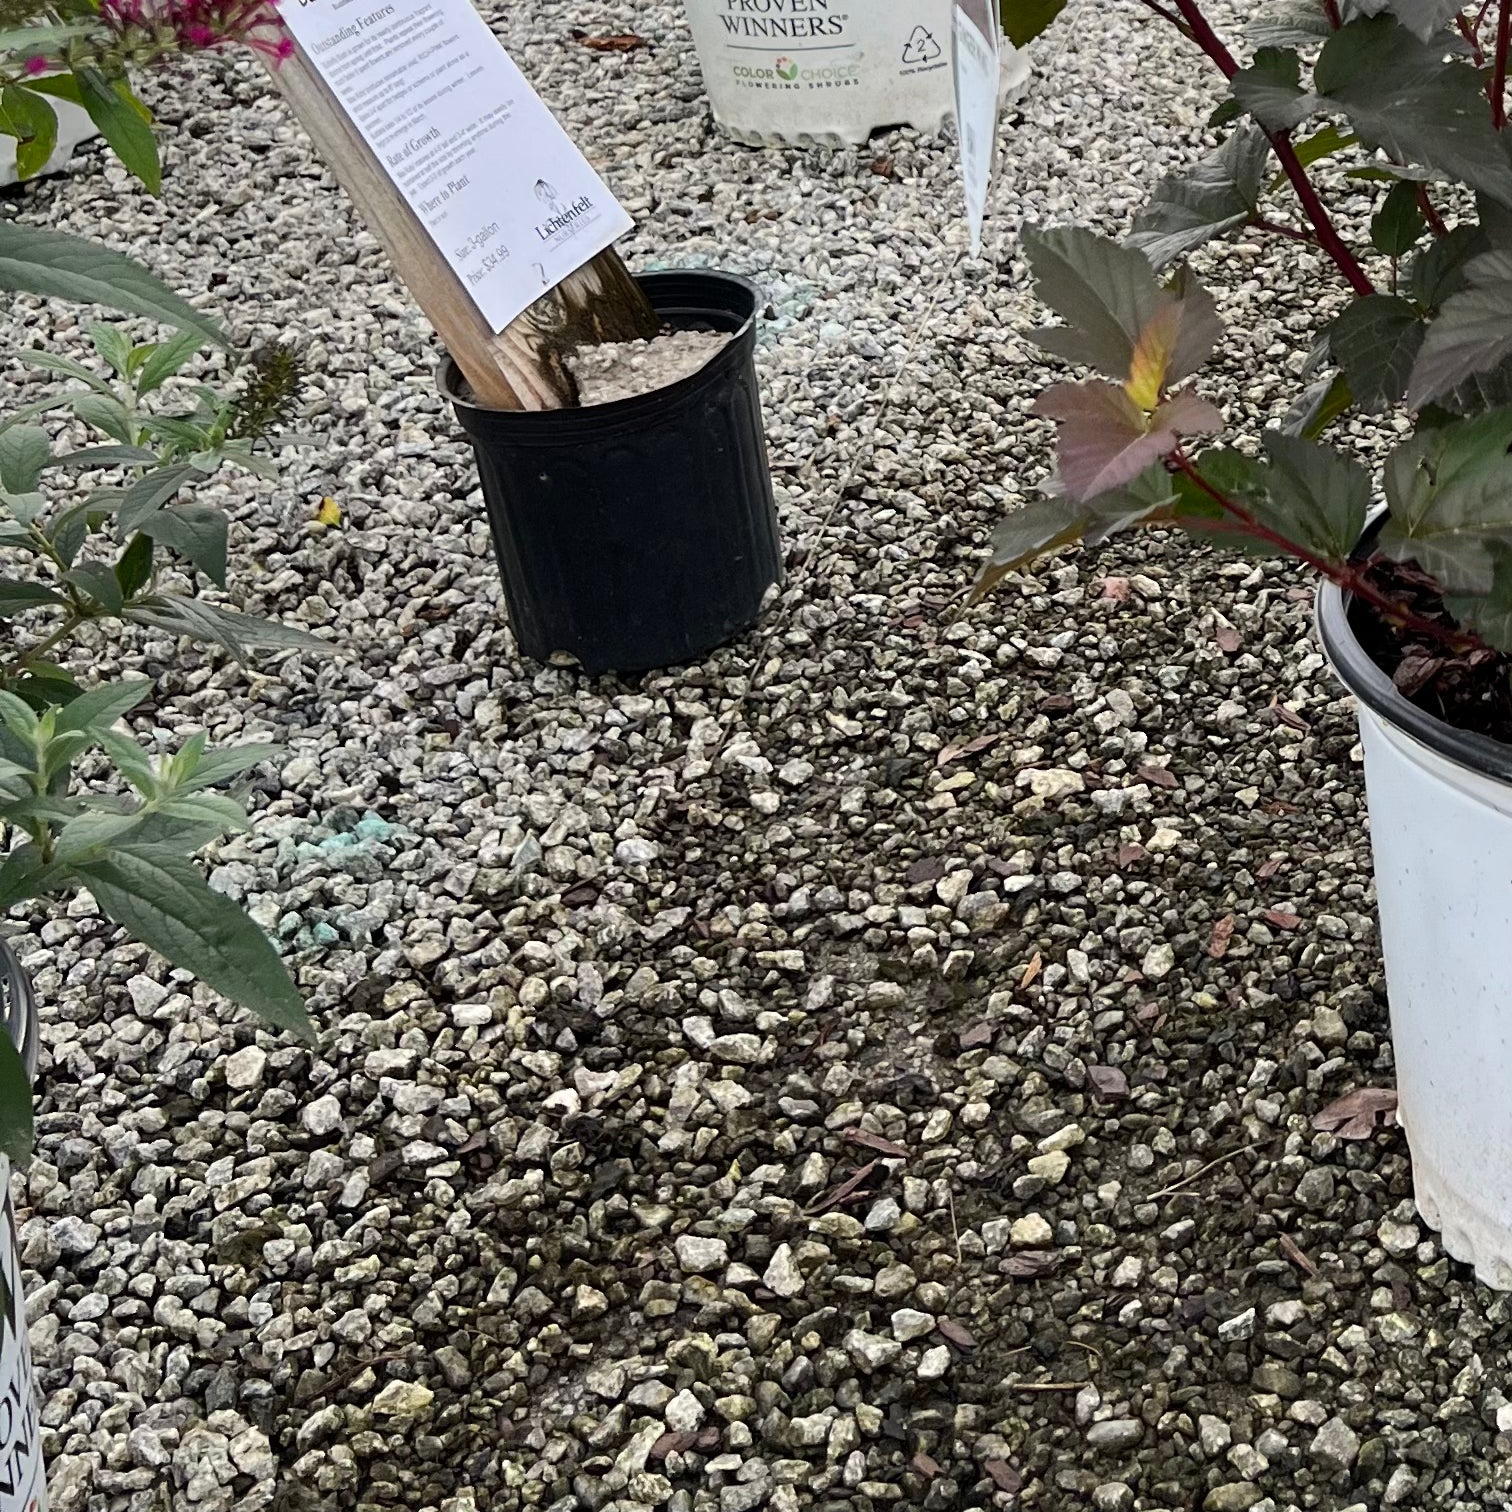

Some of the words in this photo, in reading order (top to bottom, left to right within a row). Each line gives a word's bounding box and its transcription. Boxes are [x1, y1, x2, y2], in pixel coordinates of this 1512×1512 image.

[355, 4, 396, 31] Features
[733, 65, 775, 80] COLOR
[385, 148, 403, 168] Rate
[410, 126, 441, 154] Growth
[441, 188, 450, 202] to
[447, 174, 471, 196] Plant
[535, 195, 593, 241] Lichtenfelt
[469, 220, 501, 250] 3-gallon
